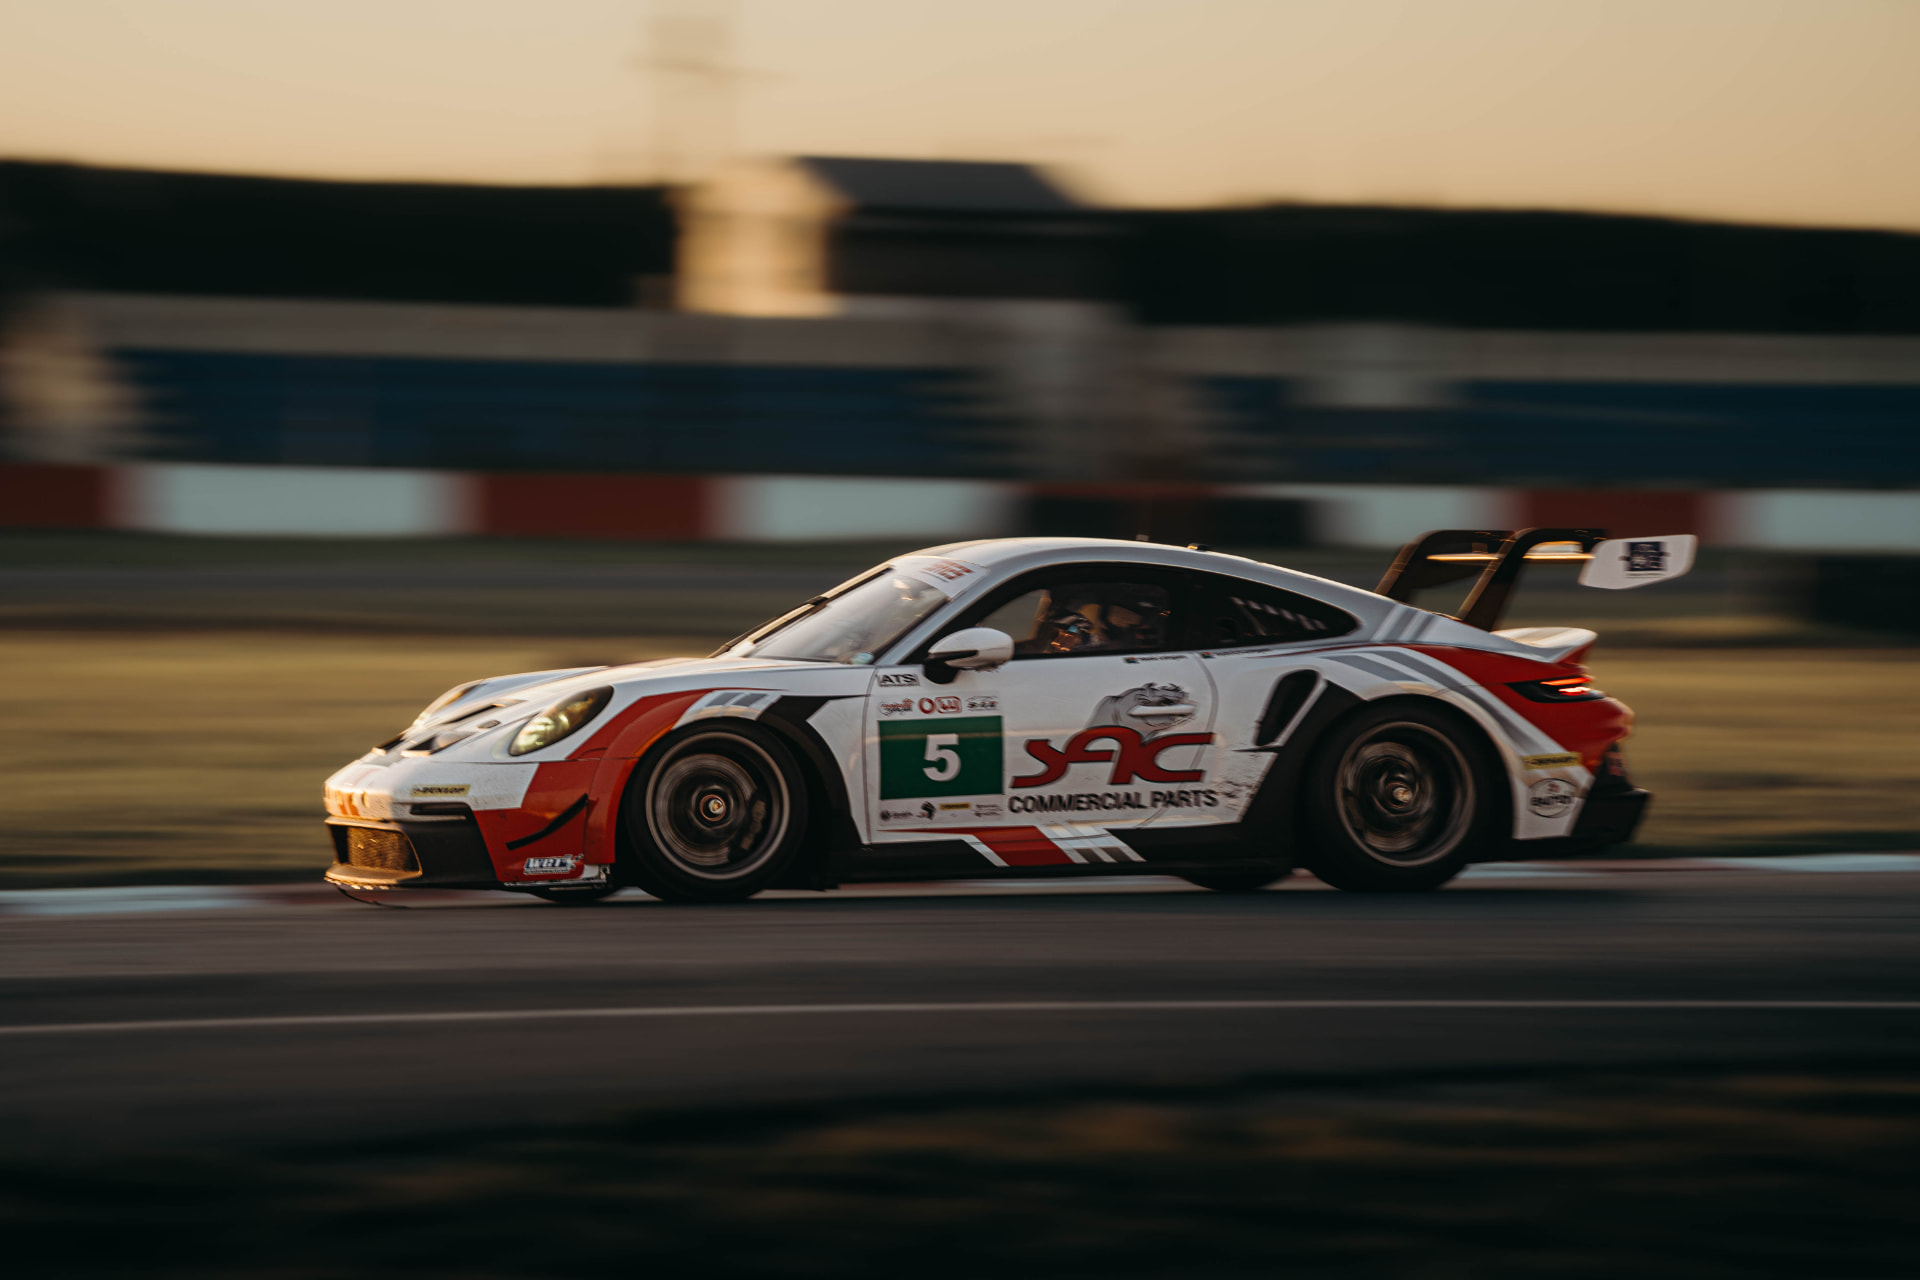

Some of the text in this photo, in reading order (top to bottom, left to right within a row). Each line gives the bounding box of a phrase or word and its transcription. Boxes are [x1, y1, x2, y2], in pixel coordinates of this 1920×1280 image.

[880, 674, 916, 684] ATS
[922, 733, 962, 782] 5
[1009, 725, 1217, 789] SAC
[1008, 792, 1144, 814] COMMERCIAL
[1150, 789, 1220, 809] PARTS
